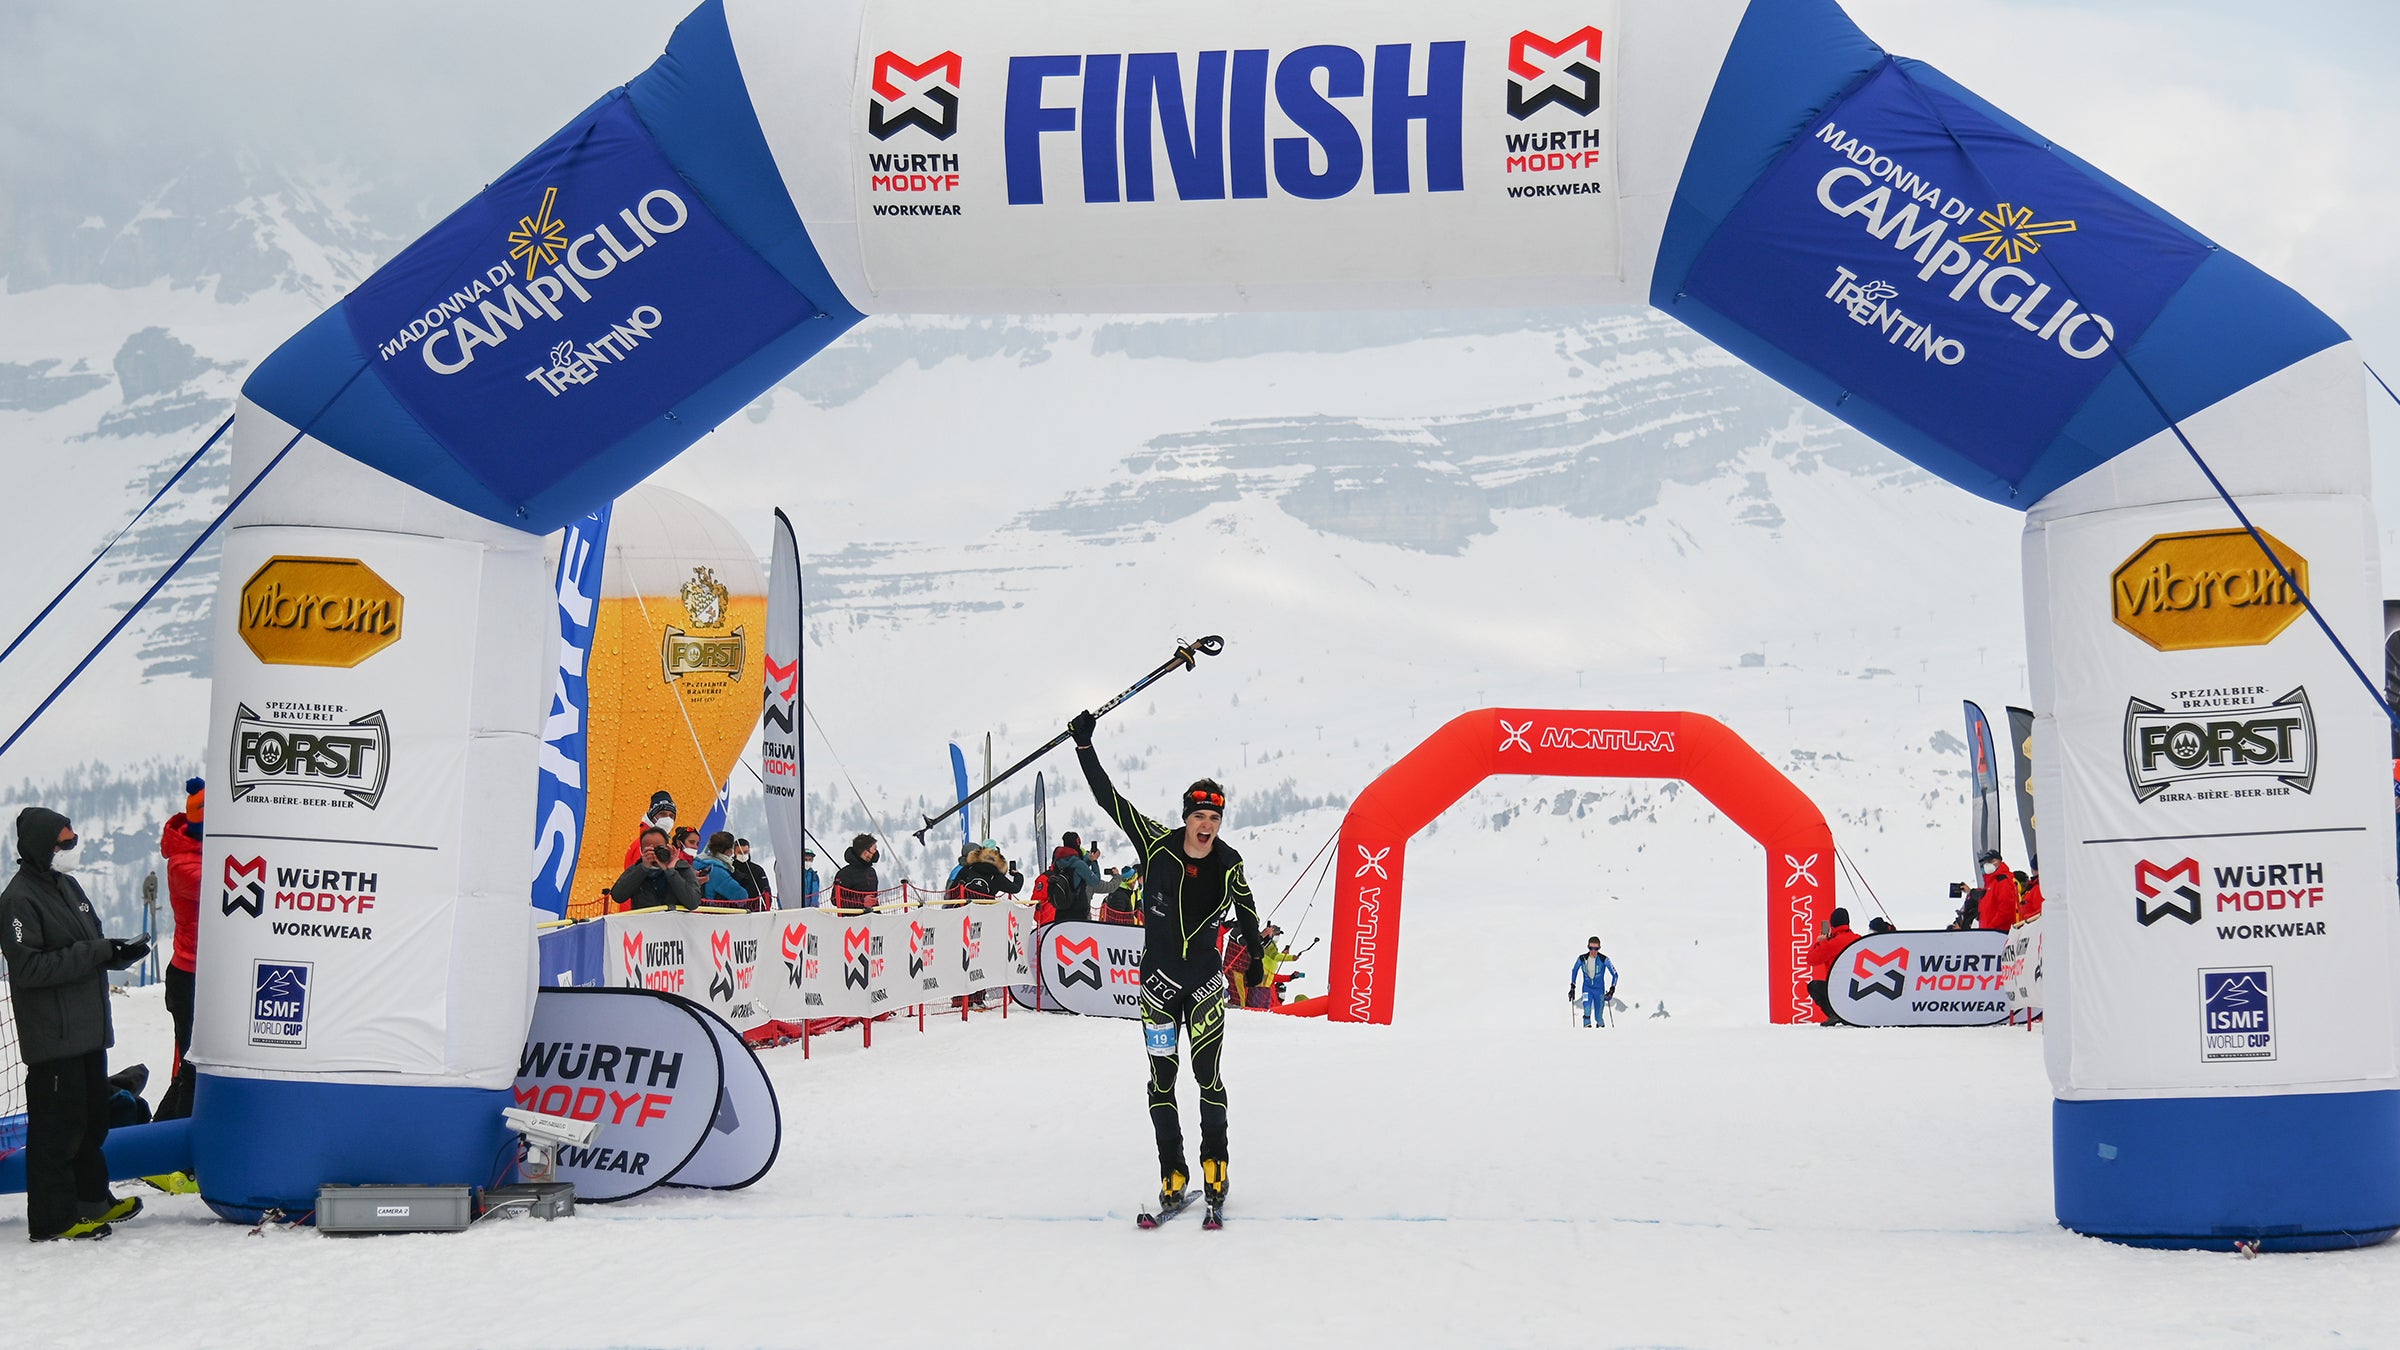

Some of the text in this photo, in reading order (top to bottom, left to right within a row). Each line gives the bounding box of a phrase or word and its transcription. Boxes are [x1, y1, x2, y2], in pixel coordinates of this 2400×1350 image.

[1006, 41, 1466, 204] FINISH
[1505, 129, 1600, 153] WÜRTH
[869, 153, 959, 172] WÜRTH
[1506, 150, 1600, 173] MODYF
[871, 174, 960, 192] MODYF
[1815, 122, 1974, 227] MADONNA DI
[1507, 182, 1601, 198] WORKWEAR
[873, 204, 962, 216] WORKWEAR
[1816, 166, 2115, 360] CAMPIGLIO
[421, 189, 689, 375] CAMPIGLIO
[378, 260, 515, 361] MADONNA DI
[1824, 266, 1966, 366] TRENTINO
[525, 305, 663, 397] TRENTINO
[2116, 562, 2303, 617] vibram
[246, 582, 396, 636] vibram
[672, 642, 740, 669] FORST
[2182, 696, 2256, 709] BRAUEREI
[272, 711, 334, 722] BRAUEREI
[1540, 726, 1675, 752] MONTURA
[2139, 717, 2303, 771] FORST
[238, 730, 377, 779] FORST
[277, 867, 378, 893] WÜRTH
[2214, 862, 2324, 888] WÜRTH
[275, 891, 376, 914] MODYF
[2217, 887, 2324, 912] MODYF
[272, 922, 372, 940] WORKWEAR
[2216, 921, 2326, 940] WORKWEAR
[1350, 887, 1381, 1021] MONTURA
[645, 968, 685, 993] MODYF
[1146, 973, 1177, 1000] FFG
[1915, 974, 2005, 991] MODYF
[258, 999, 301, 1018] ISMF
[1911, 1001, 2006, 1013] WORKWEAR
[2211, 1010, 2264, 1029] ISMF
[253, 1020, 303, 1036] WORLD CUP
[1153, 1033, 1168, 1045] 19
[2206, 1033, 2271, 1049] WORLD CUP
[513, 1084, 673, 1127] MODYF
